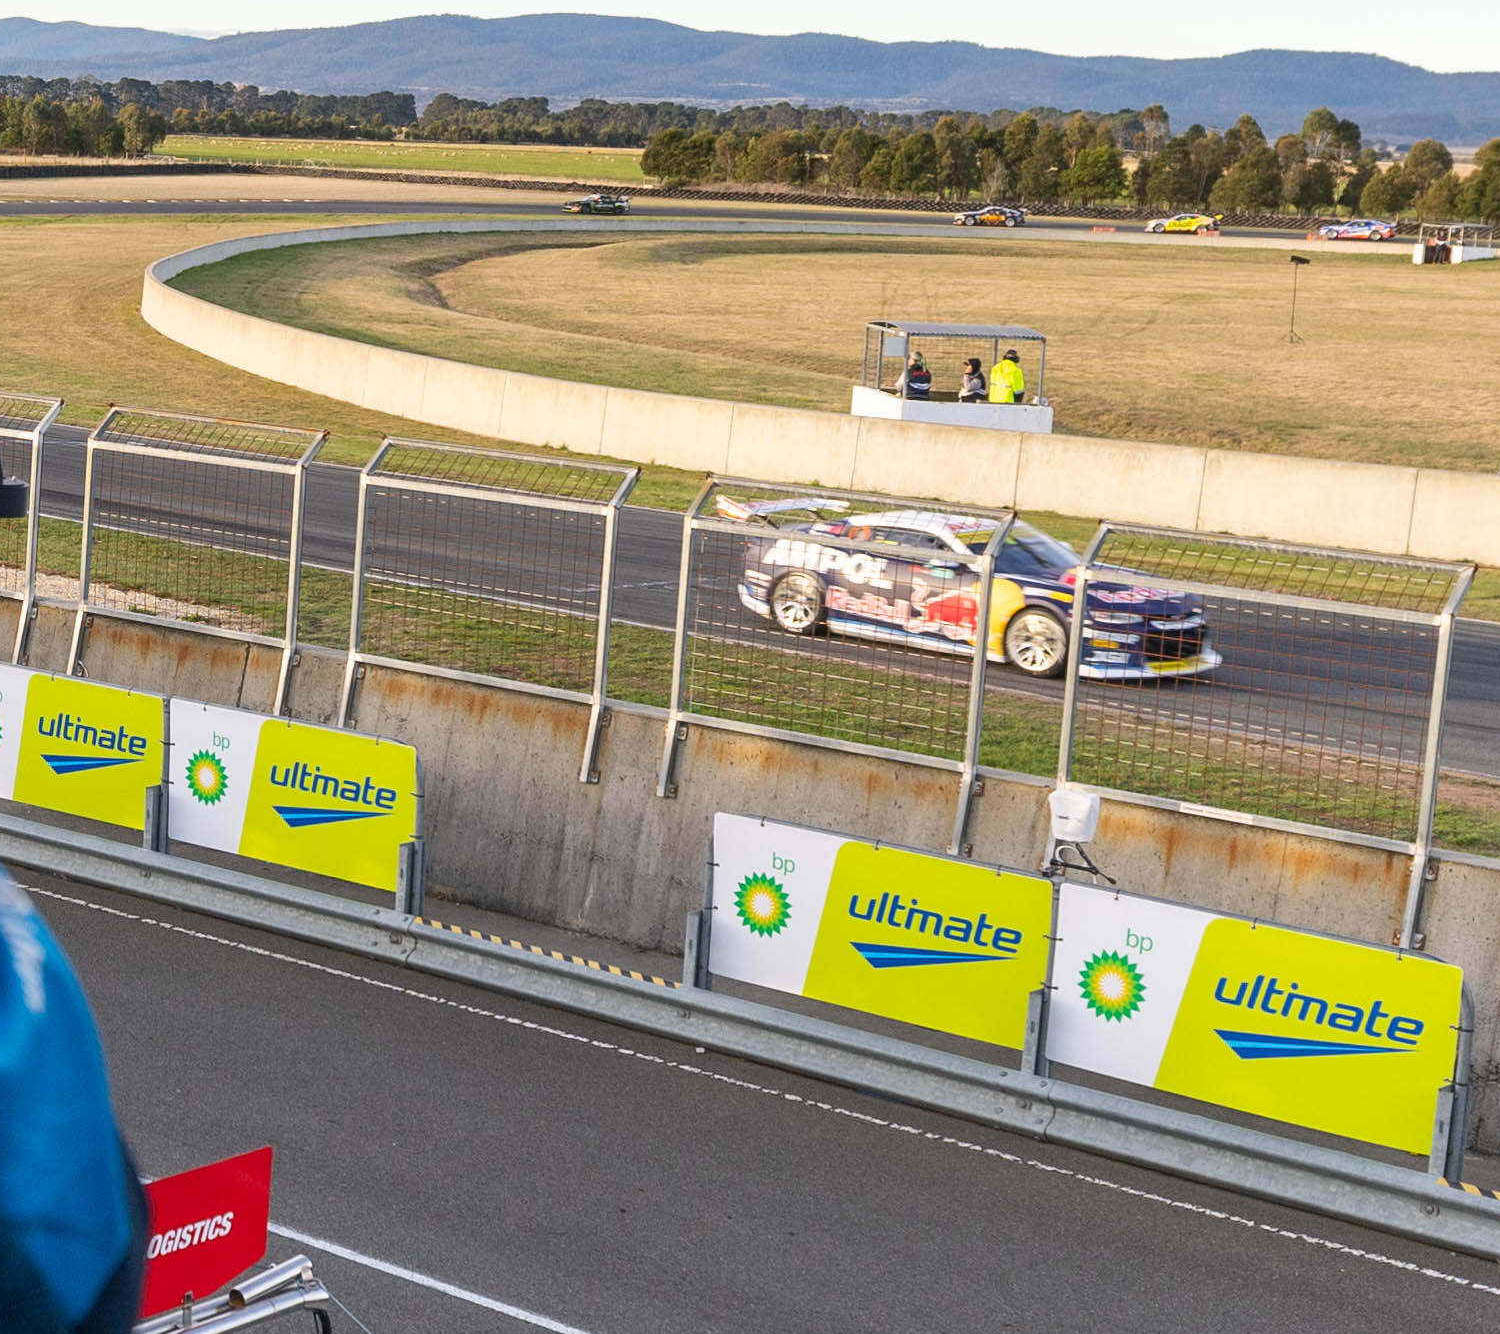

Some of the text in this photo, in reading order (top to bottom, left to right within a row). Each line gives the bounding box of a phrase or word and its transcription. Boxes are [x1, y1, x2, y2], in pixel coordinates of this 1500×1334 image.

[38, 712, 147, 757] ultimate
[212, 730, 231, 751] bp
[270, 761, 397, 810] ultimate
[771, 851, 796, 876] bp
[848, 891, 1023, 954] ultimate
[1126, 927, 1154, 955] bp
[1213, 974, 1425, 1046] ultimate
[146, 1210, 235, 1260] OGISTICS
